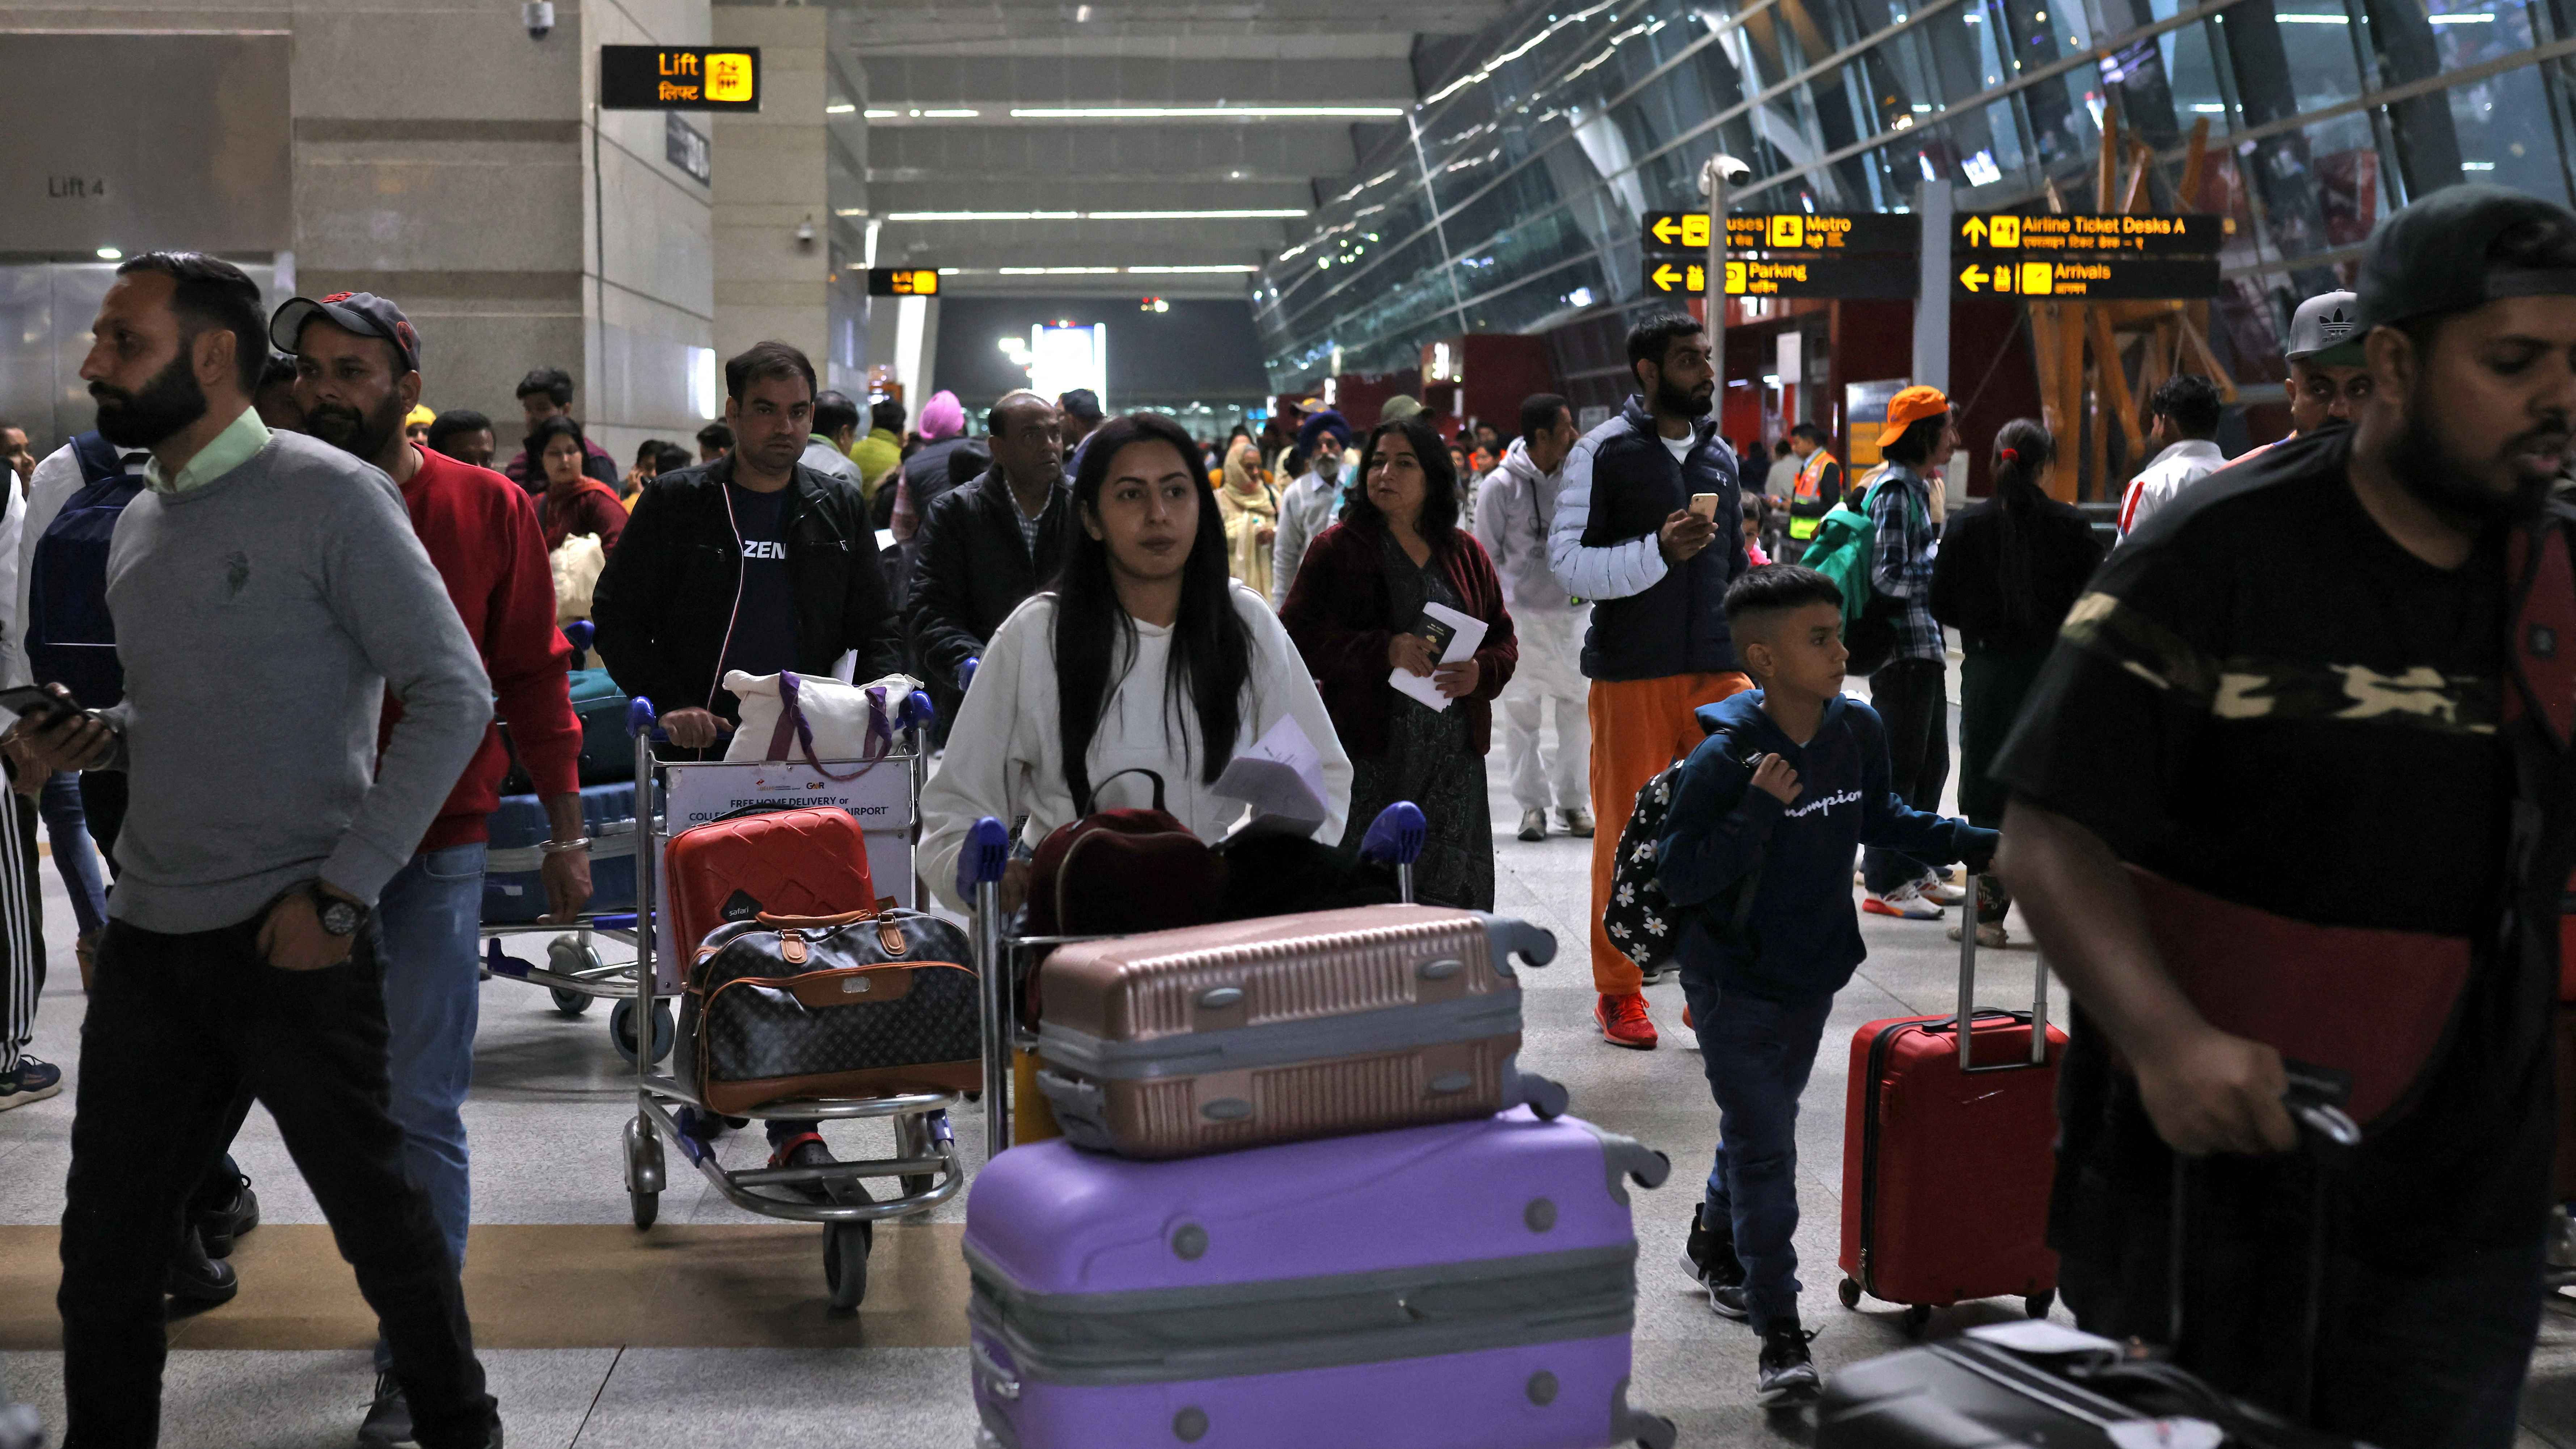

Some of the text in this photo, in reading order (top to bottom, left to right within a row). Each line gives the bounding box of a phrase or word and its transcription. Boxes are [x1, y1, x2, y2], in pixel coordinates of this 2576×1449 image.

[659, 52, 699, 75] Lift
[48, 176, 104, 198] Lift 4
[1726, 218, 1764, 231] uses
[1806, 215, 1851, 232] Metro
[2022, 216, 2186, 234] Airline Ticket Desks A
[1749, 262, 1807, 282] Parking
[2055, 262, 2111, 279] Arrivals
[744, 540, 786, 559] ZEN
[730, 799, 754, 808] FREE
[789, 797, 836, 806] DELIVERY
[729, 906, 749, 916] safari
